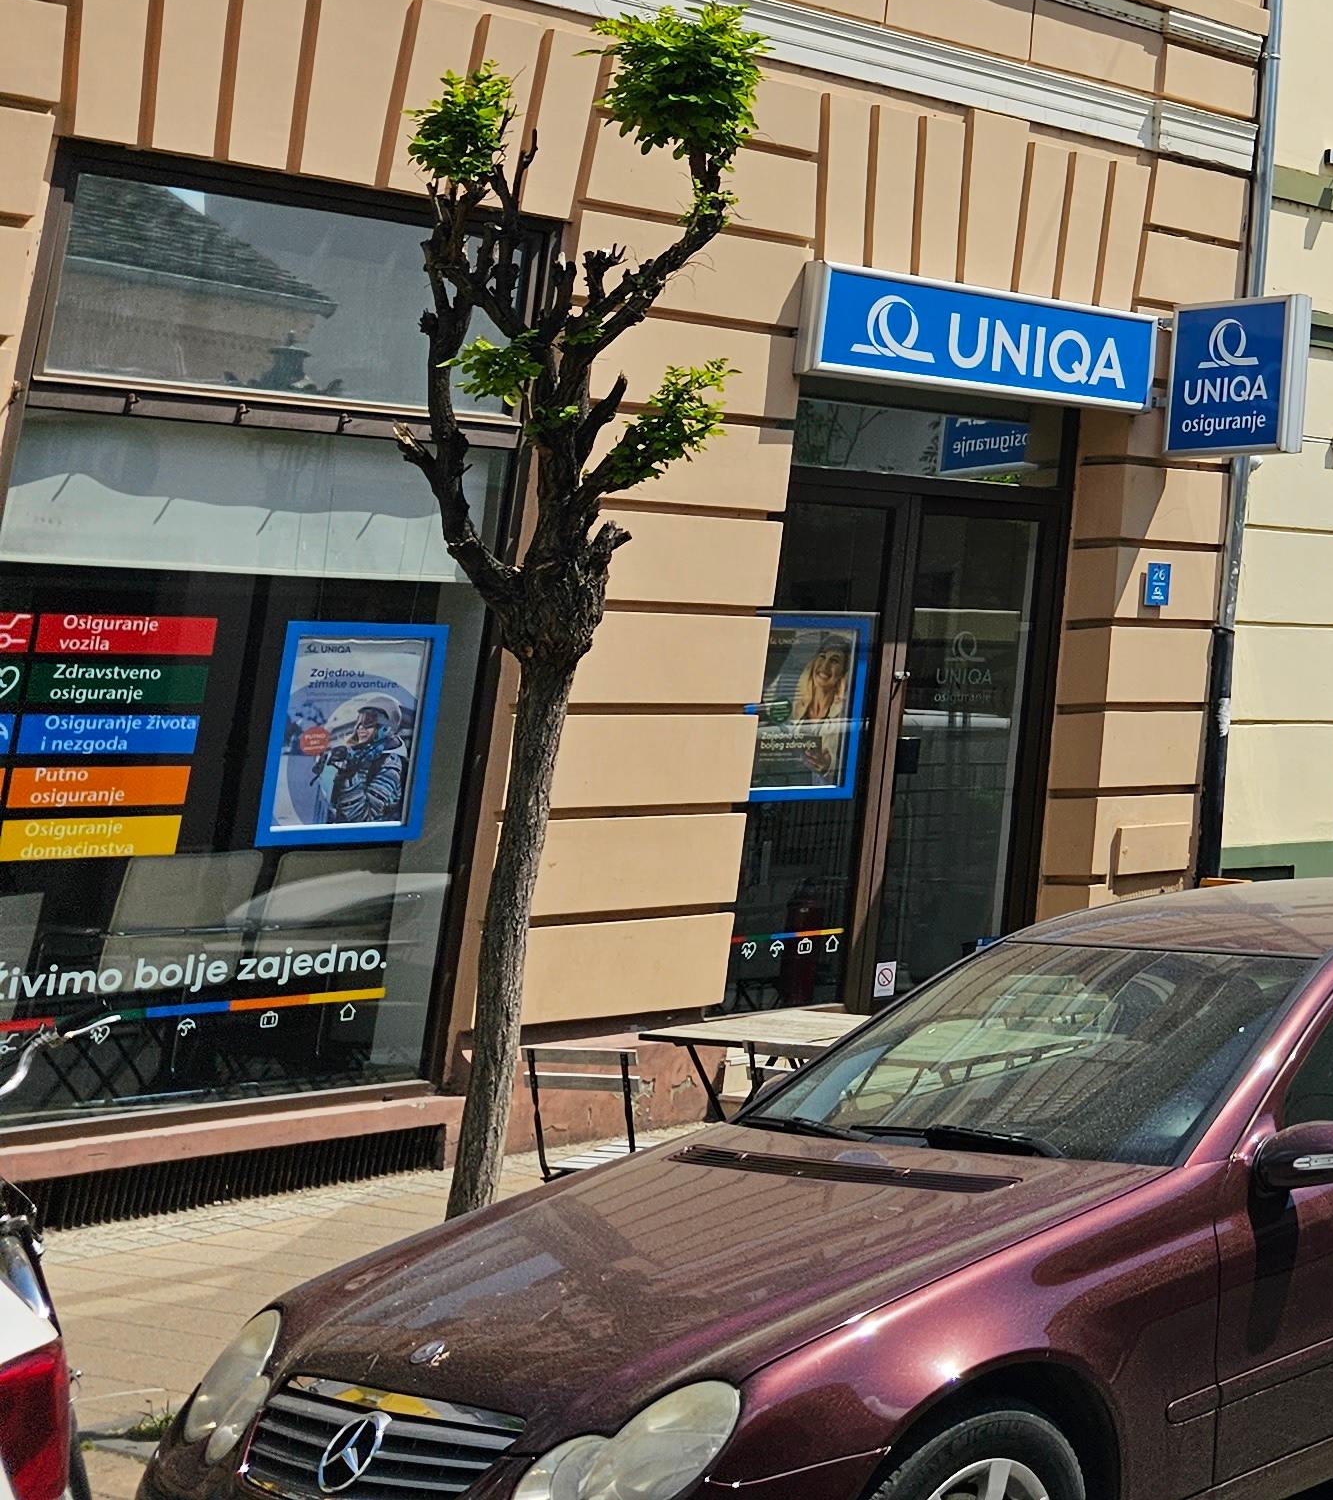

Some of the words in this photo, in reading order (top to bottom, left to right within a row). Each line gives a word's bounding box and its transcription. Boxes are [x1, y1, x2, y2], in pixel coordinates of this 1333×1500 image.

[948, 312, 1126, 390] UNIQA
[1183, 375, 1268, 405] UNIQA
[1182, 412, 1267, 437] osiguranje
[1153, 569, 1165, 581] 26
[63, 615, 159, 634] Osiguranje
[60, 636, 110, 651] vozila
[320, 644, 351, 654] UNIQA
[53, 664, 161, 679] Zdravstveno
[310, 667, 356, 679] Zajedno
[936, 667, 993, 685] UNIQA
[308, 679, 348, 689] zimske
[50, 687, 143, 703] osiguranje
[45, 714, 142, 732] Osiguranje
[146, 714, 197, 731] života
[40, 736, 47, 752] i
[52, 736, 128, 755] nezgoda
[34, 767, 89, 783] Putno
[30, 787, 125, 807] osiguranje
[25, 820, 123, 838] Osiguranje
[20, 842, 134, 859] domaćinstva
[134, 952, 228, 993] bolje
[236, 943, 388, 986] zajedno.
